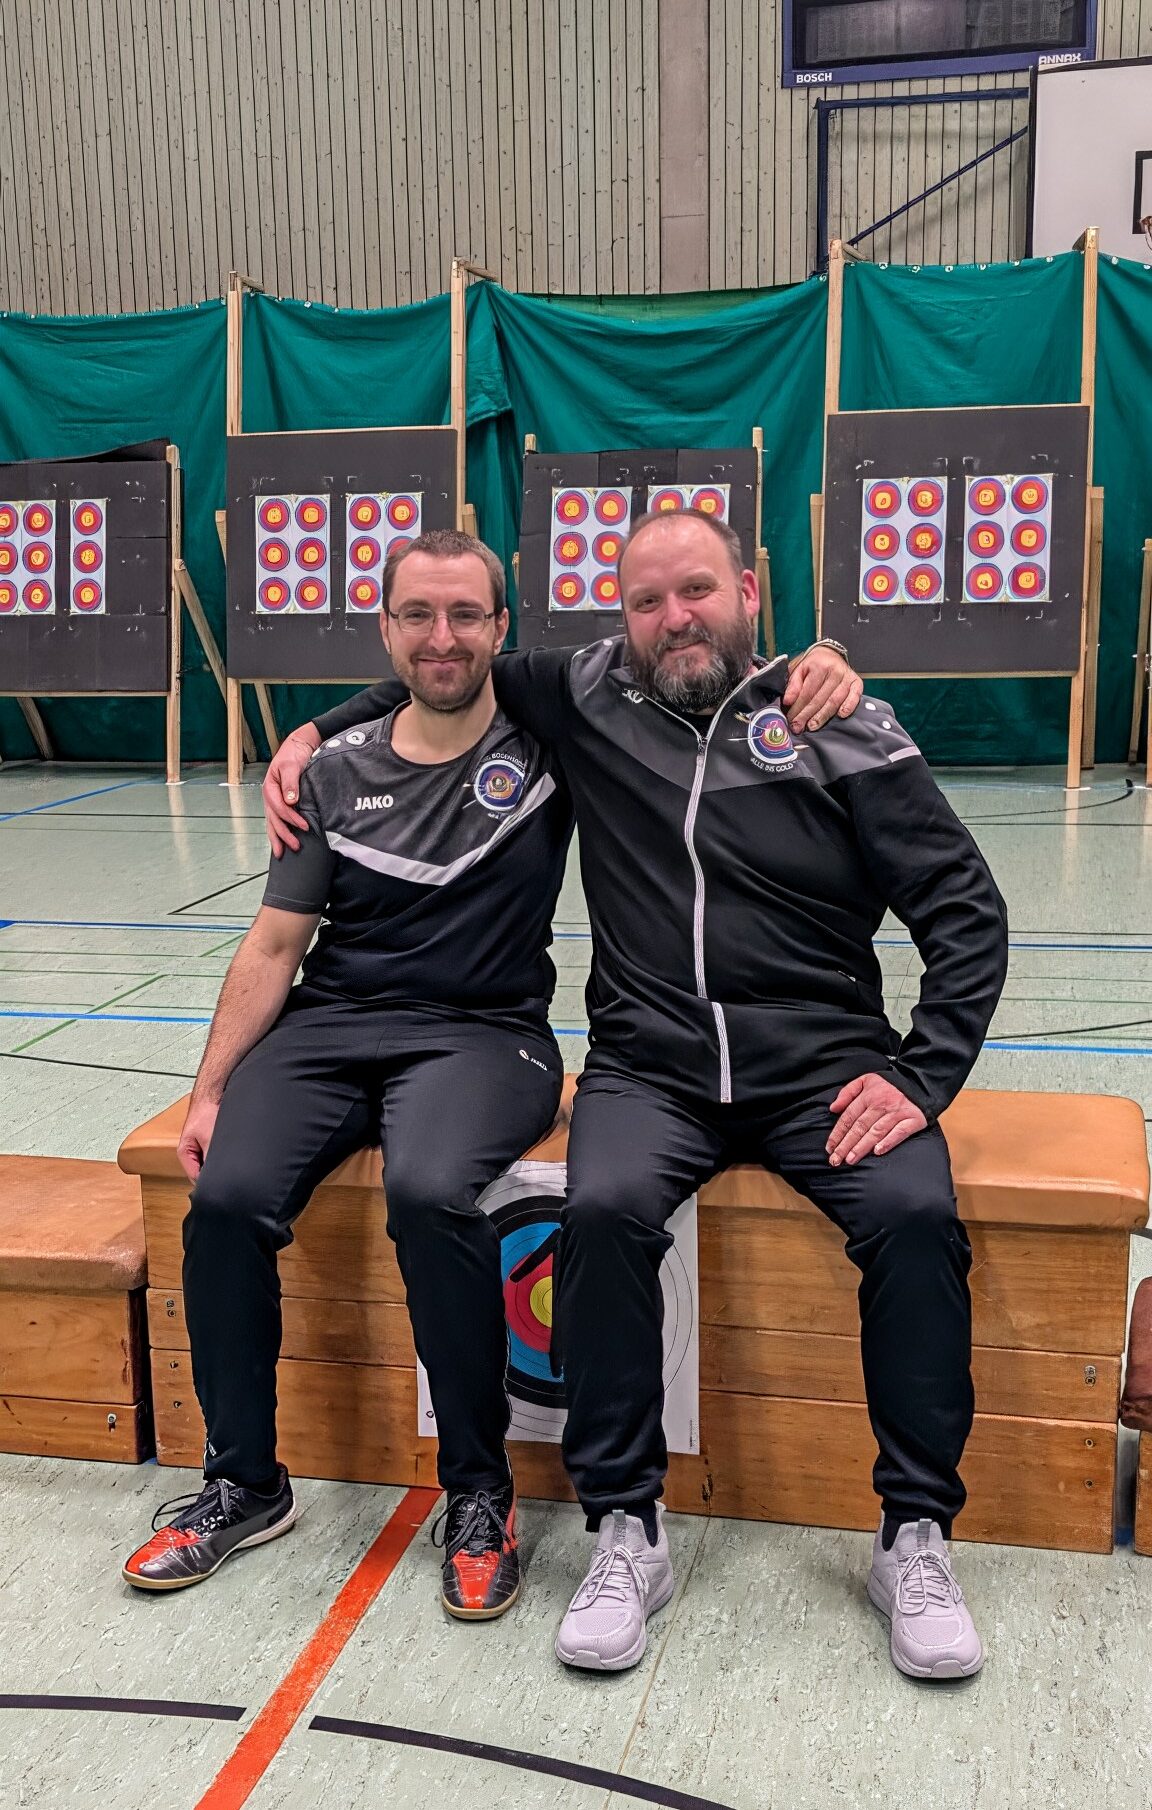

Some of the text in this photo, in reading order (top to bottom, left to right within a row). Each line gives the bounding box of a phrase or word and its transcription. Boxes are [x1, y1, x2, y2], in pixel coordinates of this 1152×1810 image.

[1038, 53, 1081, 65] ANNAX
[796, 72, 833, 84] BOSCH
[750, 757, 765, 769] ALLE
[354, 794, 394, 811] JAKO
